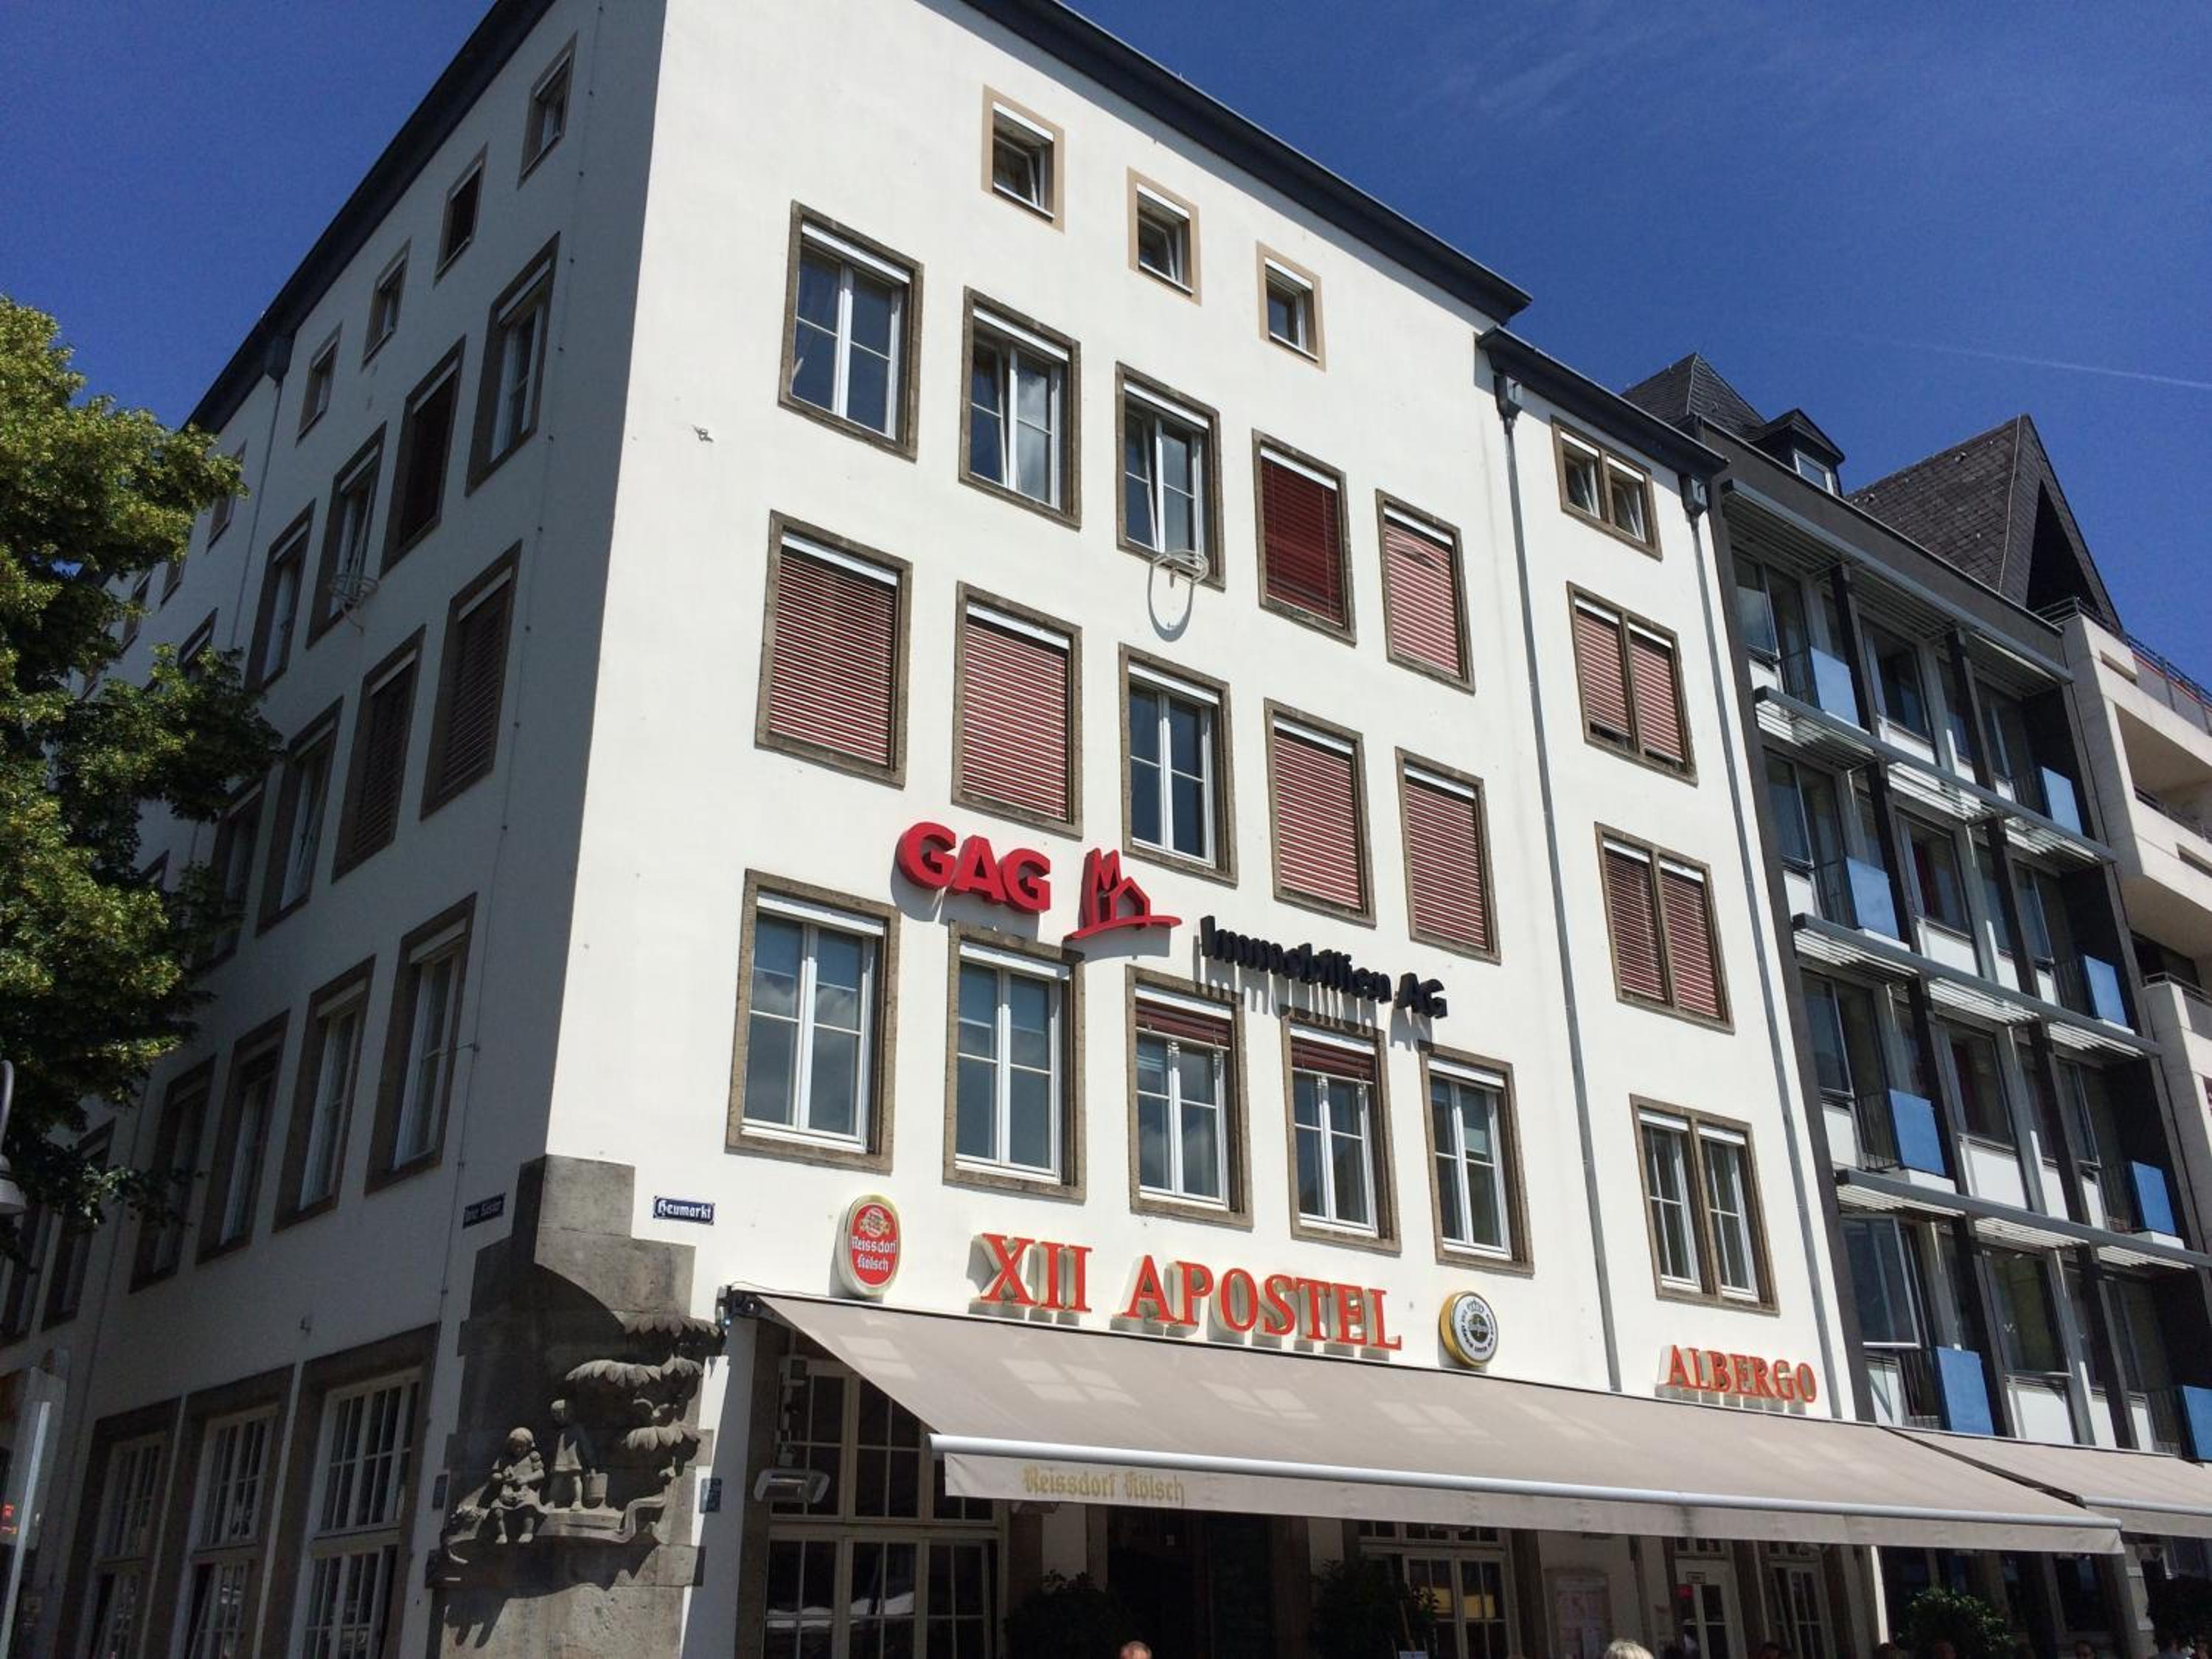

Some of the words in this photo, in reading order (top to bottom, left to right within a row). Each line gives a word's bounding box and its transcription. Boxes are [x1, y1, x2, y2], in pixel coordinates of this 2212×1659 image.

[895, 821, 1051, 914] GAG
[1200, 915, 1392, 1004] Immobilien
[1397, 972, 1447, 1019] AG
[657, 1199, 712, 1220] Heumarkt
[978, 1232, 1093, 1314] XII
[1118, 1254, 1402, 1351] APOSTEL
[1665, 1344, 1818, 1403] ALBERGO
[1021, 1462, 1116, 1499] Reissdorf
[1124, 1470, 1186, 1508] Kölsch
